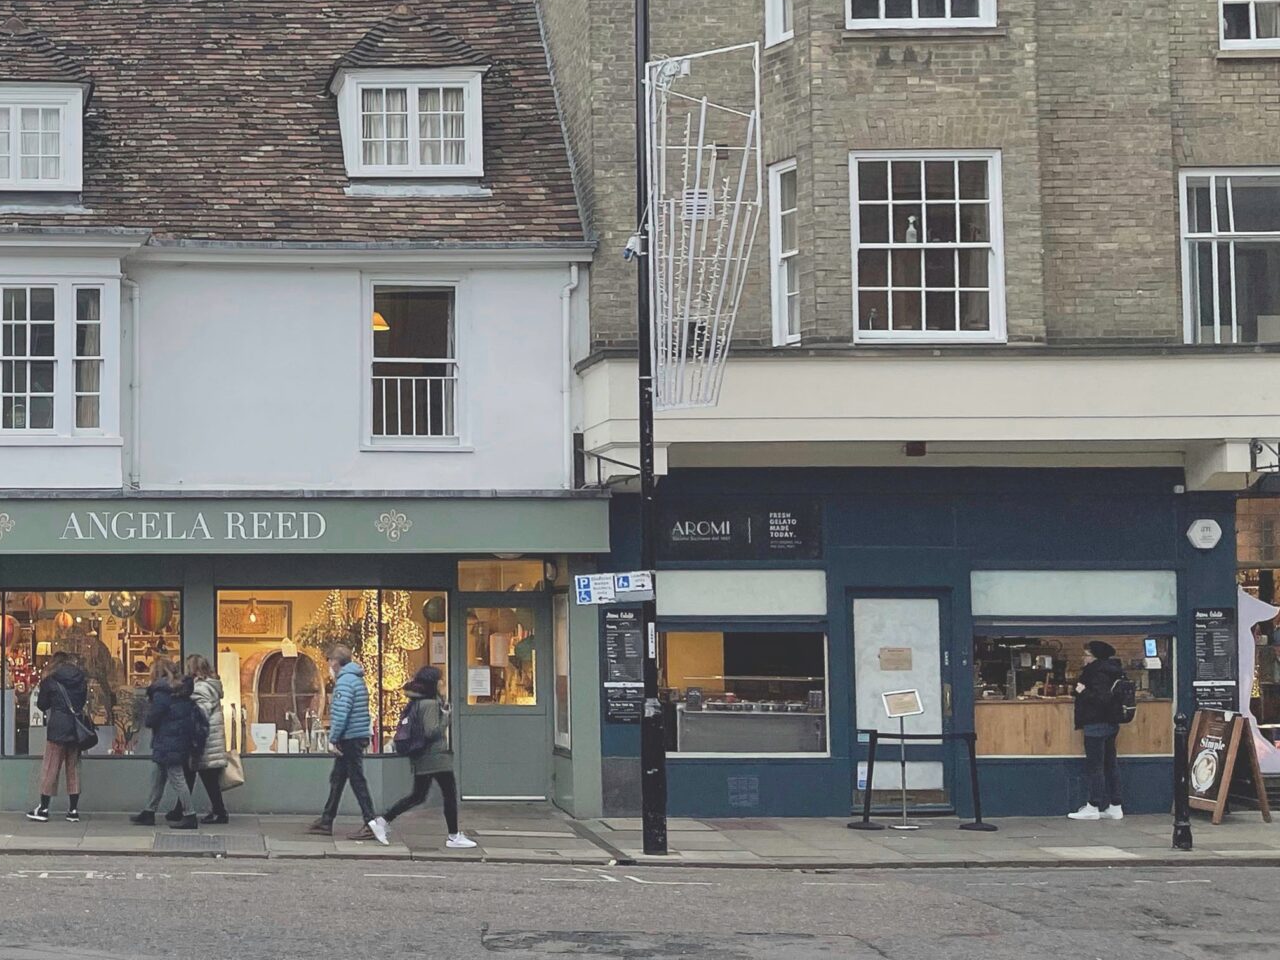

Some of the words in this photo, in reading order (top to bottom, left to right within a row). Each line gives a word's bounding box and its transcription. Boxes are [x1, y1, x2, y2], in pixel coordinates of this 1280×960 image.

[59, 511, 214, 540] ANGELA
[223, 511, 327, 540] REED
[671, 520, 731, 536] AROMI
